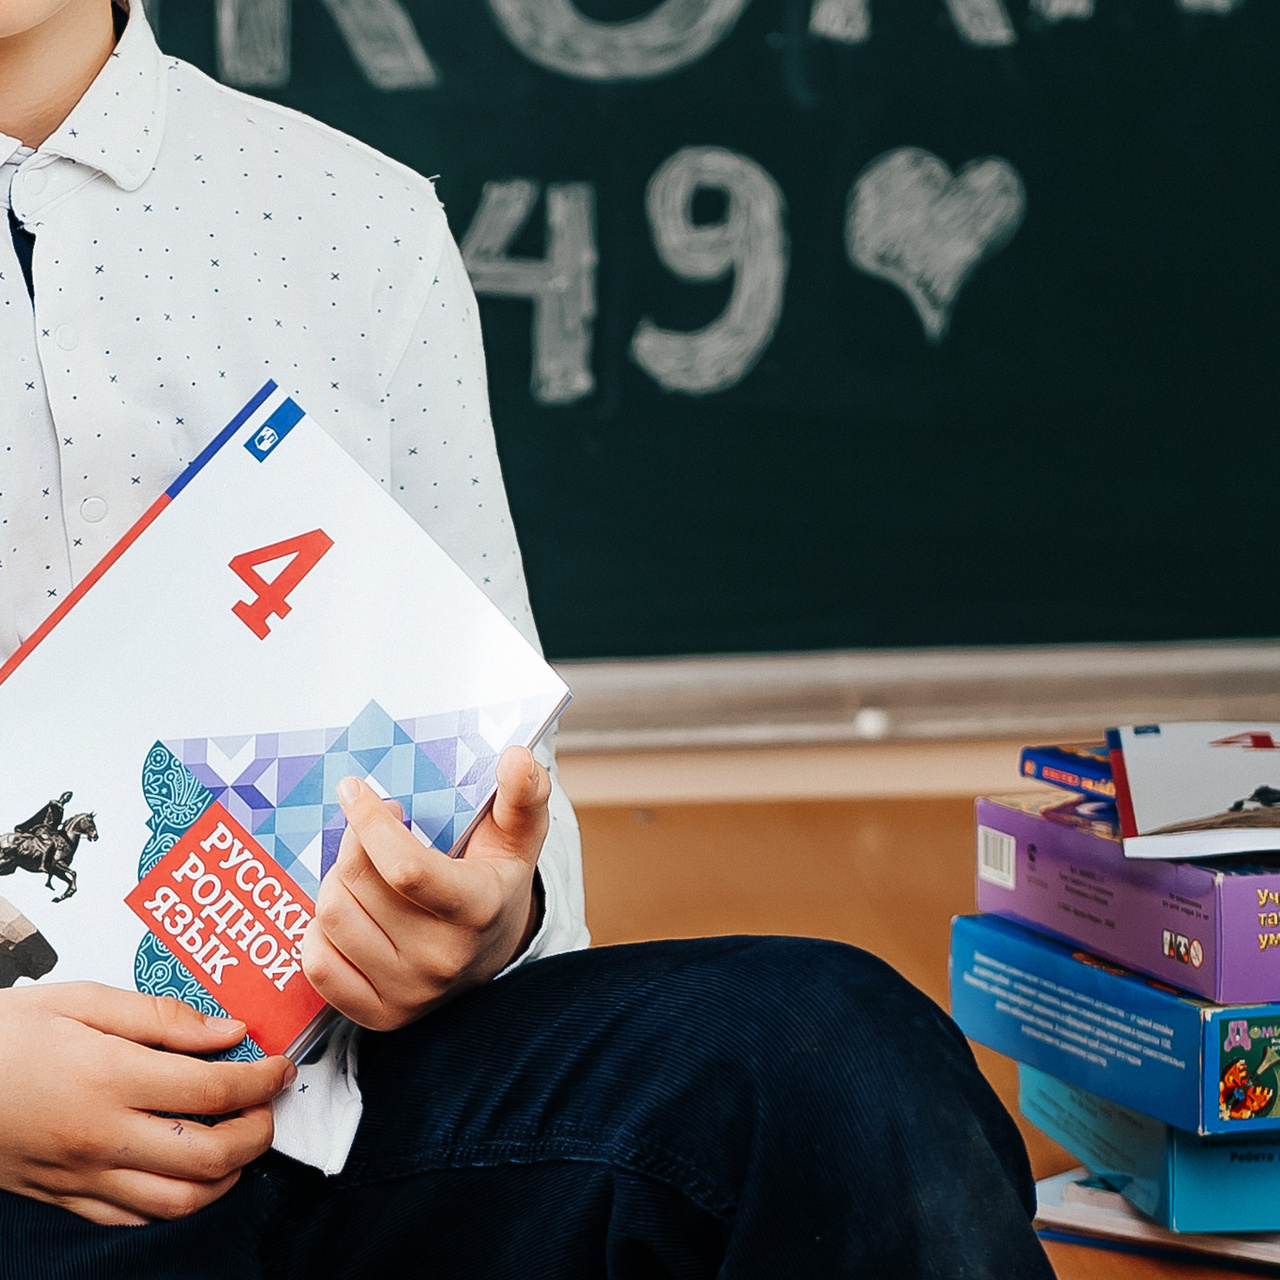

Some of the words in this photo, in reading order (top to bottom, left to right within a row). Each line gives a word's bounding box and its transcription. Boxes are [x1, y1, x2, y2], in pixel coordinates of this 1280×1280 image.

[463, 145, 791, 406] 49
[228, 528, 335, 640] 4
[143, 886, 239, 985] ЯЗЫК
[171, 851, 302, 992] РОДНОЙ
[199, 821, 311, 952] РУССКИ
